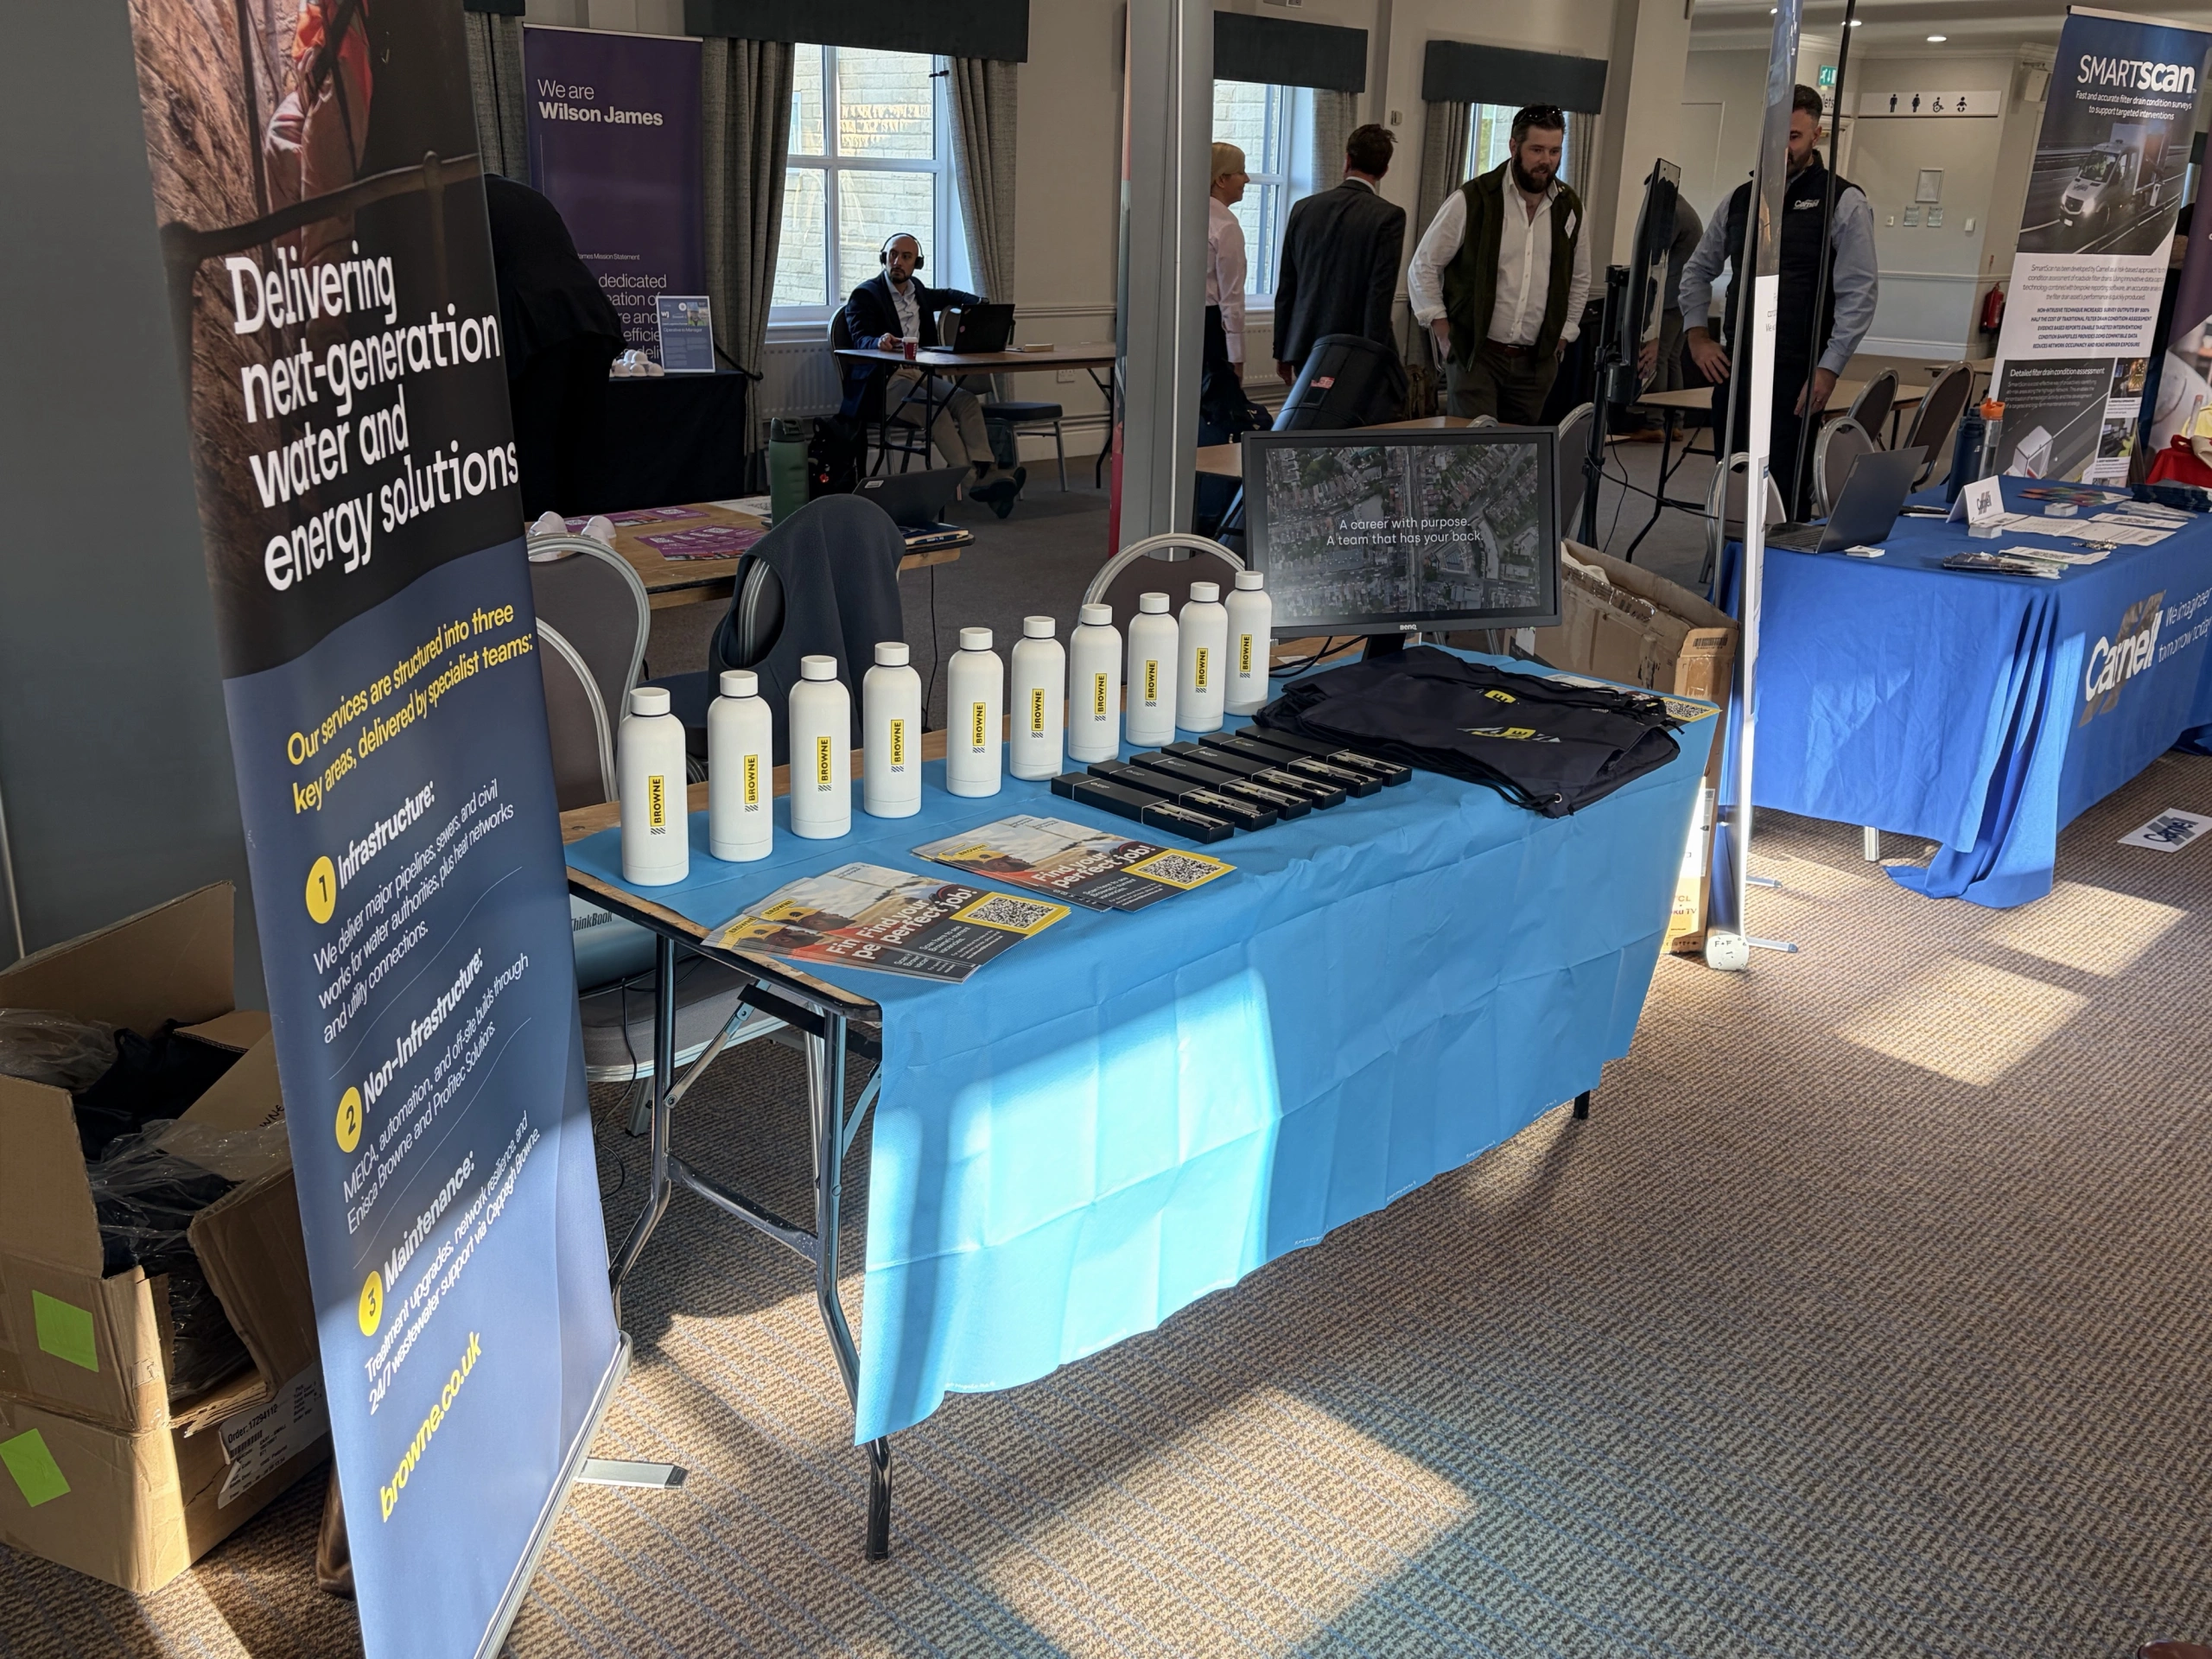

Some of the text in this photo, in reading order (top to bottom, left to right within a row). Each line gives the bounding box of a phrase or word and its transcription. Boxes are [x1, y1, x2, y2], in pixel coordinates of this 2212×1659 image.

[537, 79, 594, 100] We are
[538, 101, 663, 125] Wilson James
[2075, 90, 2087, 100] Fast
[2098, 94, 2120, 103] accurate
[2133, 97, 2146, 105] drain
[2146, 99, 2171, 108] condition
[2171, 101, 2192, 111] surveys
[2095, 107, 2116, 117] support
[2116, 108, 2139, 118] targeted
[2139, 110, 2175, 120] interventions
[226, 241, 397, 335] Delivering
[599, 273, 667, 289] dedicated
[241, 303, 501, 423] next-generation
[249, 384, 410, 509] water and
[264, 440, 519, 591] energy solutions
[1326, 530, 1484, 546] A team that has your back.
[1339, 518, 1471, 533] A career with purpose.
[1147, 662, 1156, 699] BROWNE
[2086, 610, 2164, 702] Carnell
[288, 604, 515, 766] Our services are structured into three
[1034, 690, 1043, 729] BROWNE
[292, 633, 534, 815] key areas, delivered by specialist teams:
[893, 721, 902, 763] BROWNE
[975, 704, 983, 745] BROWNE
[747, 757, 757, 802] BROWNE
[820, 739, 830, 782] BROWNE
[652, 778, 664, 823] BROWNE
[318, 781, 435, 903] 1 Infrastructure:
[1031, 852, 1109, 881] Find your
[1051, 845, 1155, 888] perfect job!
[313, 779, 499, 975] We deliver major pipelines, sewers, and civil
[318, 803, 514, 1009] works for water authorities, plus heat networks
[764, 900, 793, 915] BROWNE
[855, 899, 931, 938] Find your
[880, 900, 948, 945] perfect
[940, 887, 978, 910] job!
[324, 919, 429, 1044] and utility connections.
[346, 948, 484, 1136] 2 Non-Infrastructure:
[343, 953, 530, 1204] MEICA, automation, and off-site builds through
[346, 1020, 496, 1235] Enisca Browne and Profitec Solutions.
[365, 1110, 528, 1382] Treatment upgrades, network resilience, and
[367, 1150, 474, 1317] 3 Maintenance:
[369, 1128, 540, 1416] 24/7 wastewater support via Cappagh Browne.
[228, 1426, 248, 1444] Order:
[379, 1331, 481, 1523] browne.co.uk
